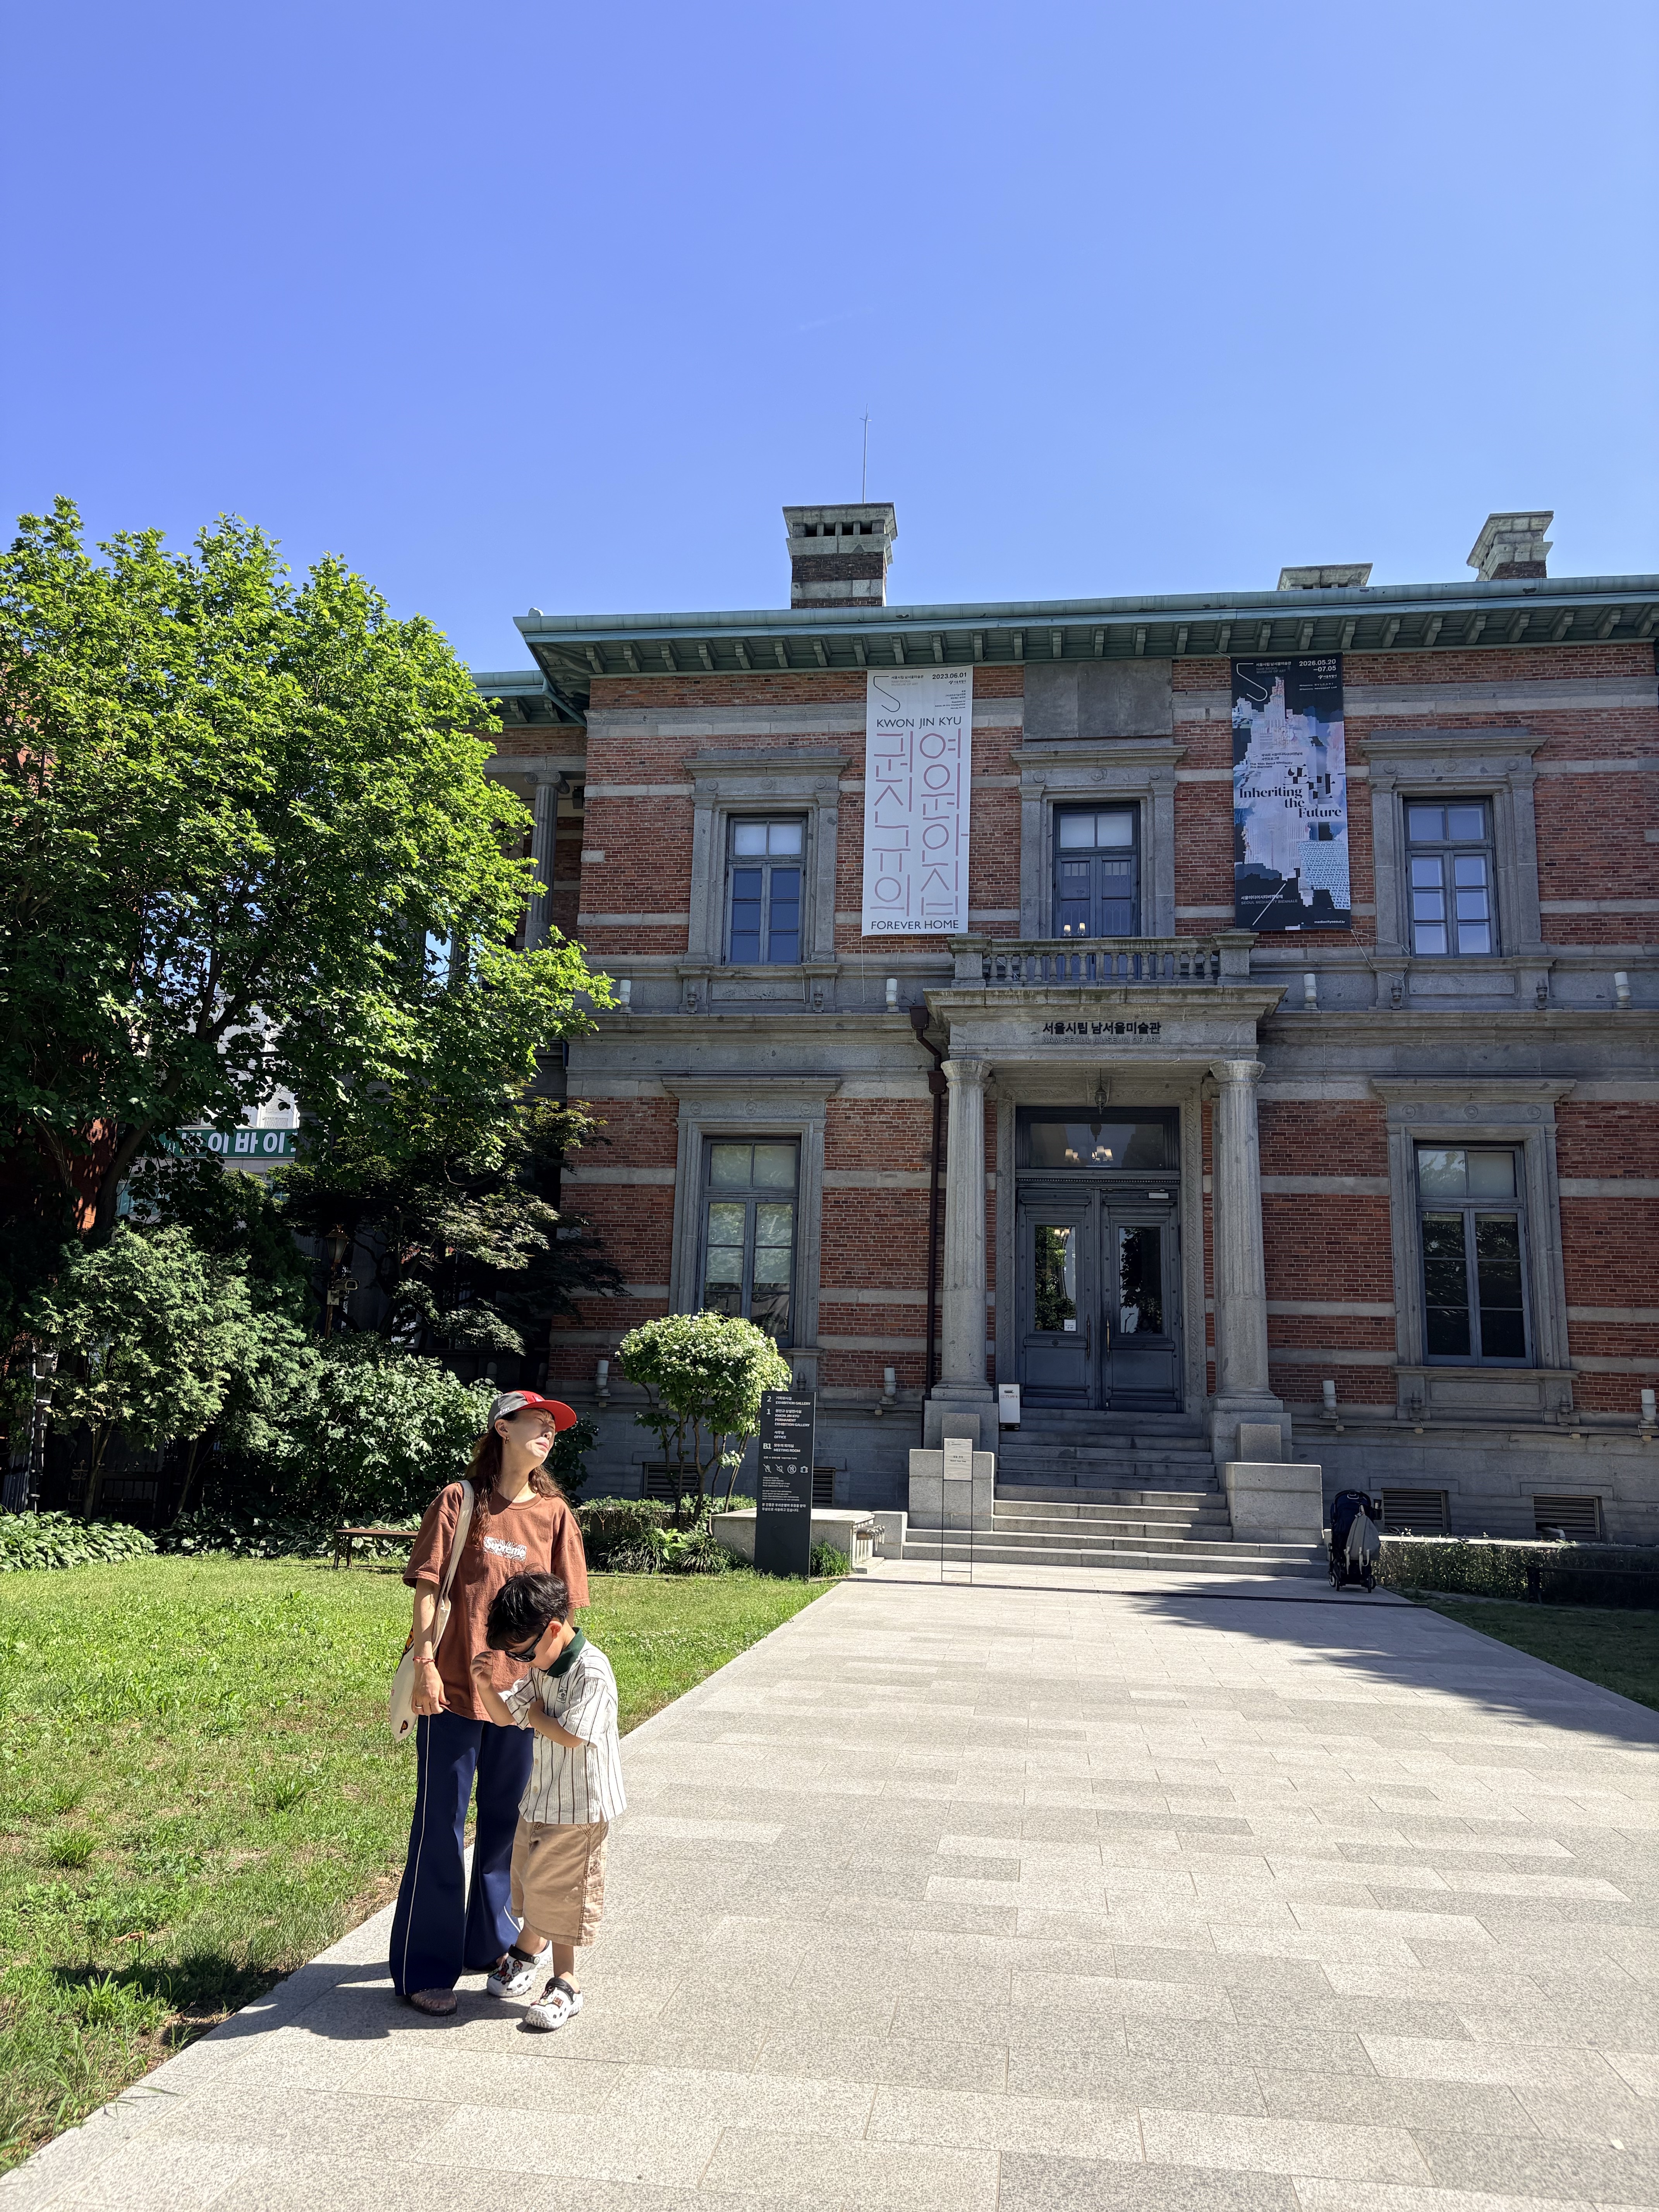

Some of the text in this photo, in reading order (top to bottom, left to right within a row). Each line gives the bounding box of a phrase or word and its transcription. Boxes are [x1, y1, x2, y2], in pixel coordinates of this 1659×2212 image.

[877, 716, 961, 729] KWON JIN KYU
[1240, 787, 1302, 799] Inheriting
[1285, 798, 1305, 808] the
[1299, 807, 1342, 818] Future
[871, 920, 959, 930] FOREVER HOME
[1042, 1022, 1162, 1035] 서울시립 남서울미술관
[1043, 1036, 1091, 1044] NAM-SEOUL
[485, 1538, 526, 1558] Supreme
